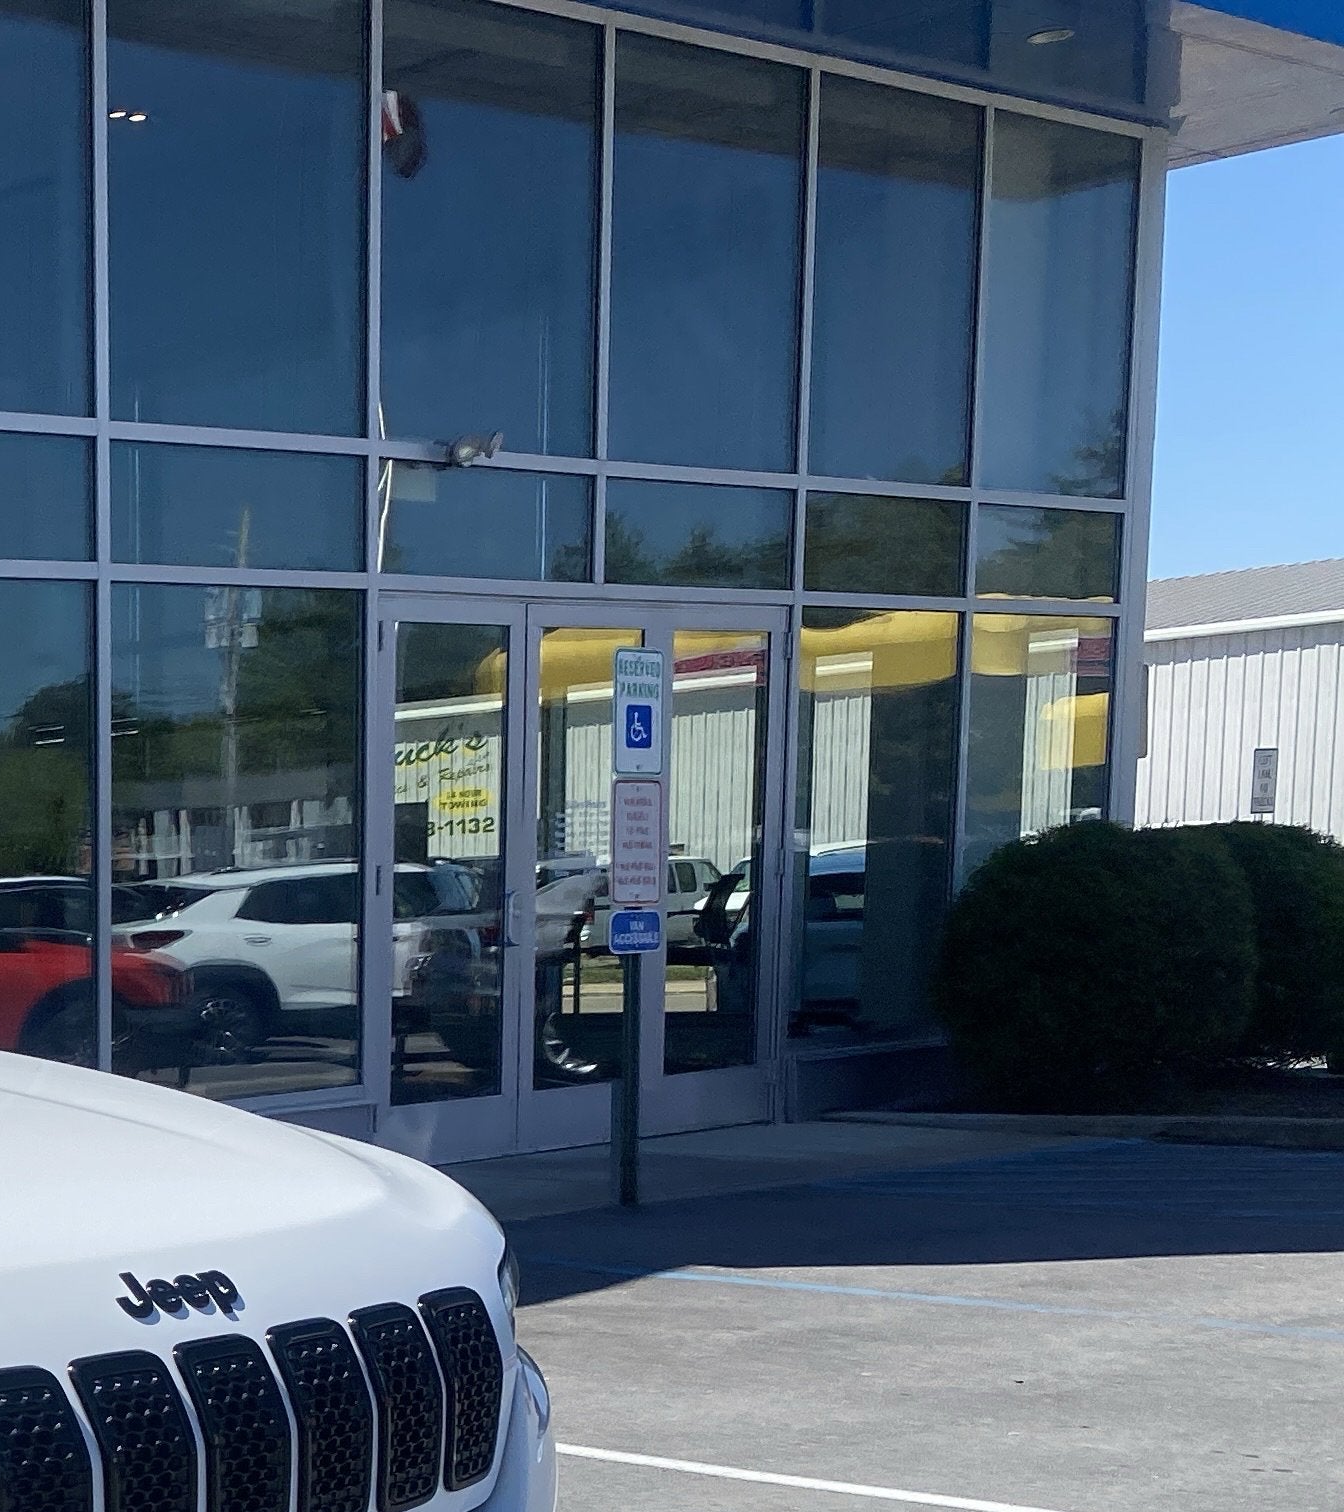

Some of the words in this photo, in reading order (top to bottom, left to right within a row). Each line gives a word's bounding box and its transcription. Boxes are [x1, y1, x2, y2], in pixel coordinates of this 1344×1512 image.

[619, 681, 660, 700] PARKING
[439, 799, 488, 809] TOWING
[115, 1269, 239, 1319] Jeep
